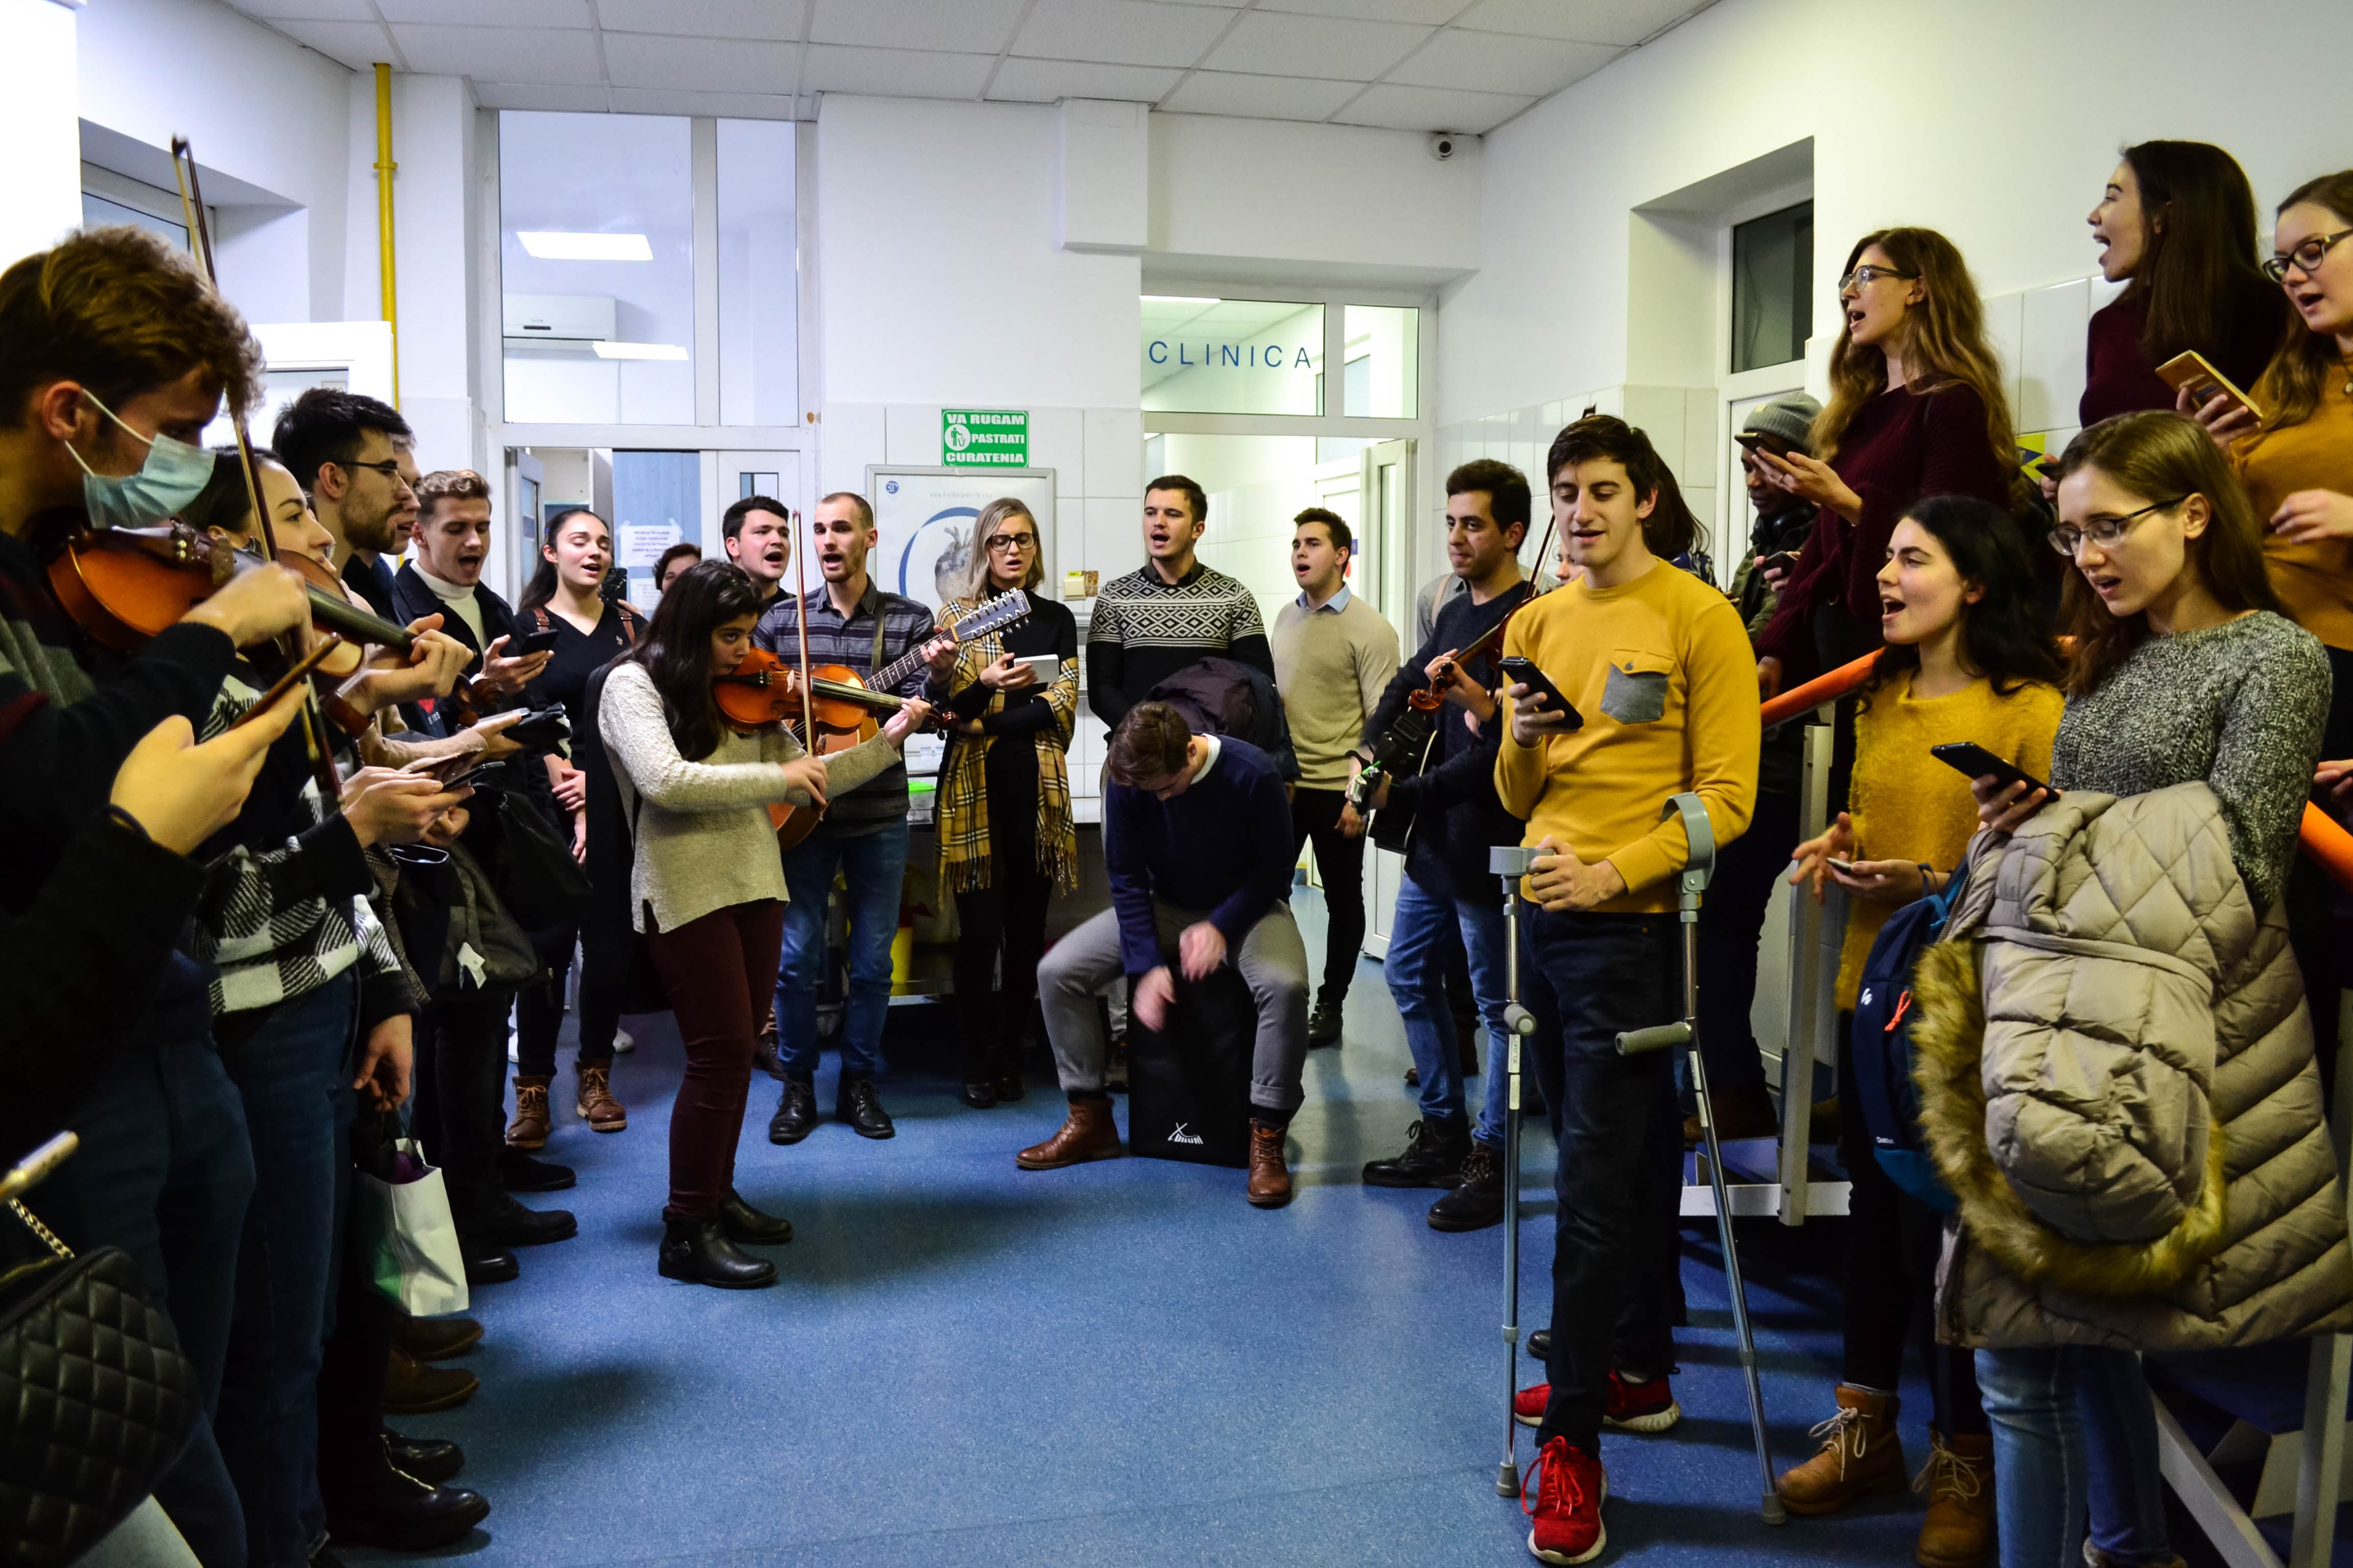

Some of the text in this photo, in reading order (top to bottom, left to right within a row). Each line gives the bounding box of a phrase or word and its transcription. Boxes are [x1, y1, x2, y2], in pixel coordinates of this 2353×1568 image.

[1148, 341, 1311, 369] CLINICA
[946, 414, 1025, 425] VA RUGAM
[971, 433, 1025, 444] PASTRATI
[946, 452, 1025, 463] CURATENIA
